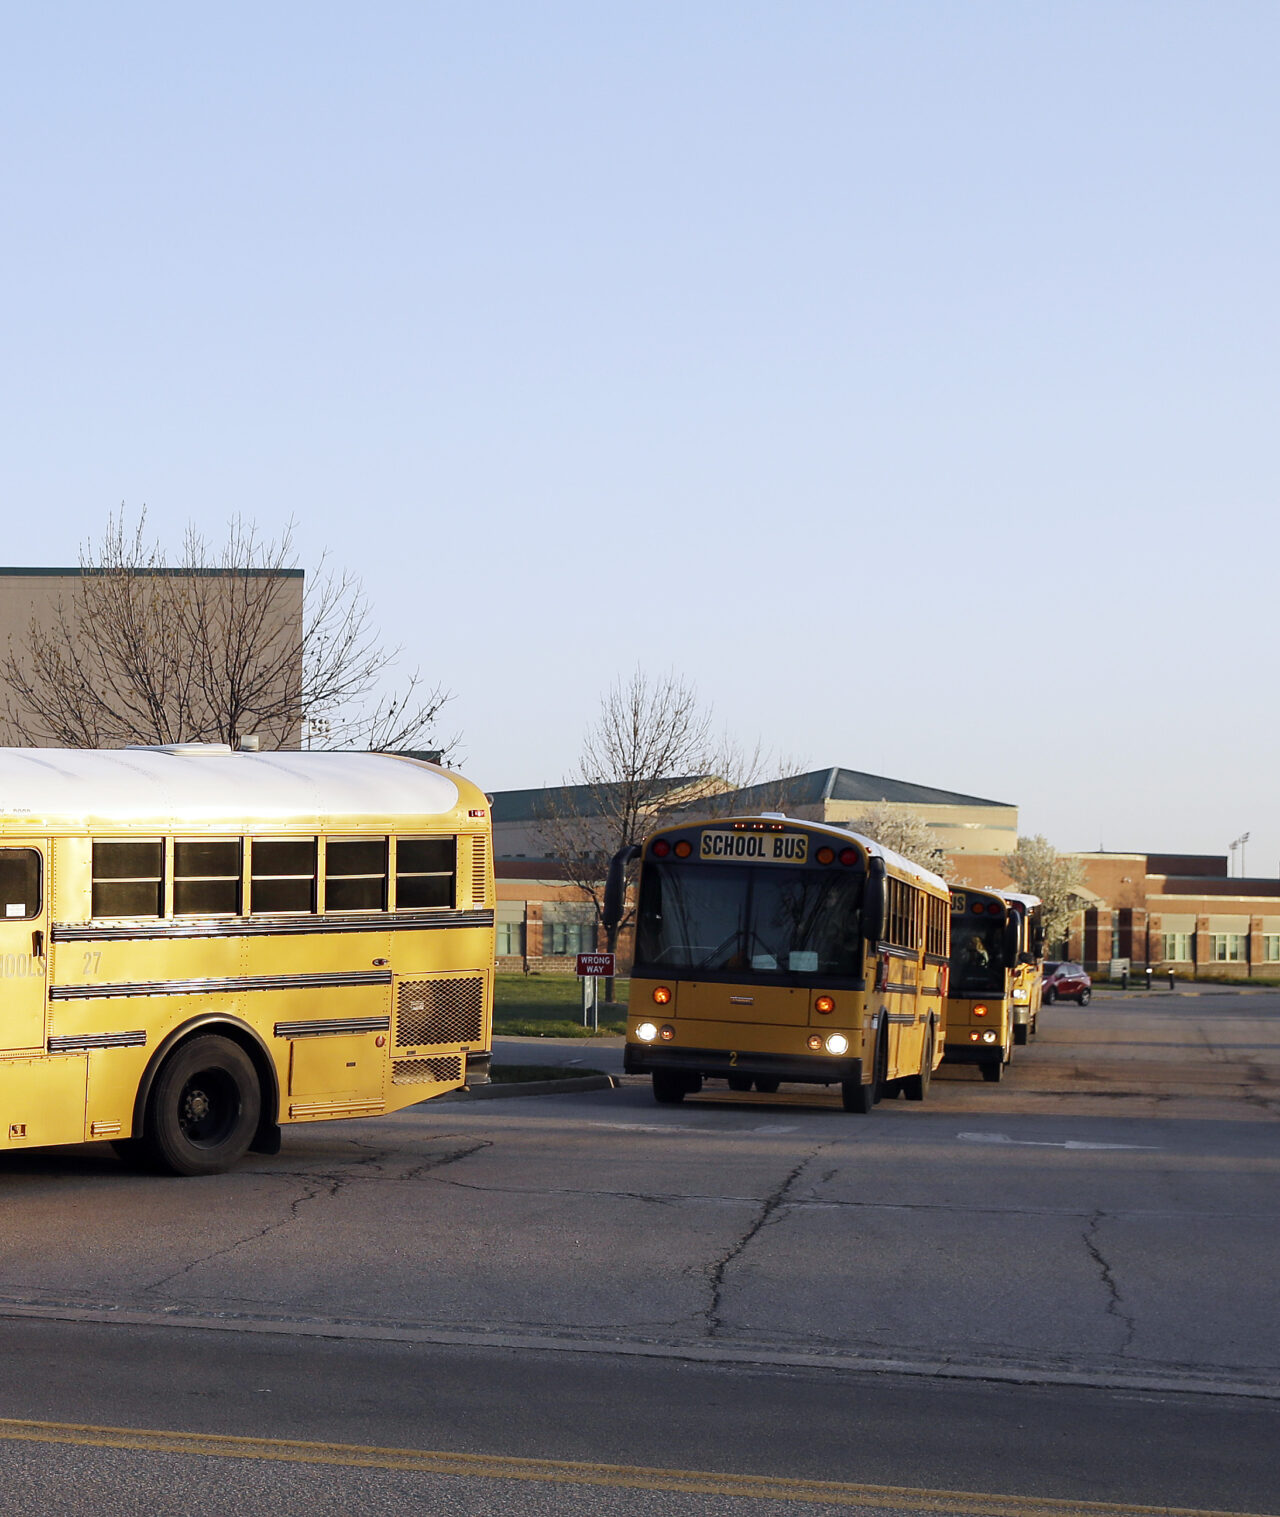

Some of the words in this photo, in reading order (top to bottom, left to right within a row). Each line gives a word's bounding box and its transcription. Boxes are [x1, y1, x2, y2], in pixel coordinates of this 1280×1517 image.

[702, 834, 766, 857] SCHOOL
[773, 837, 806, 859] BUS
[82, 951, 102, 975] 27
[581, 956, 610, 964] WRONG
[586, 965, 604, 973] WAY
[729, 1051, 738, 1067] 2
